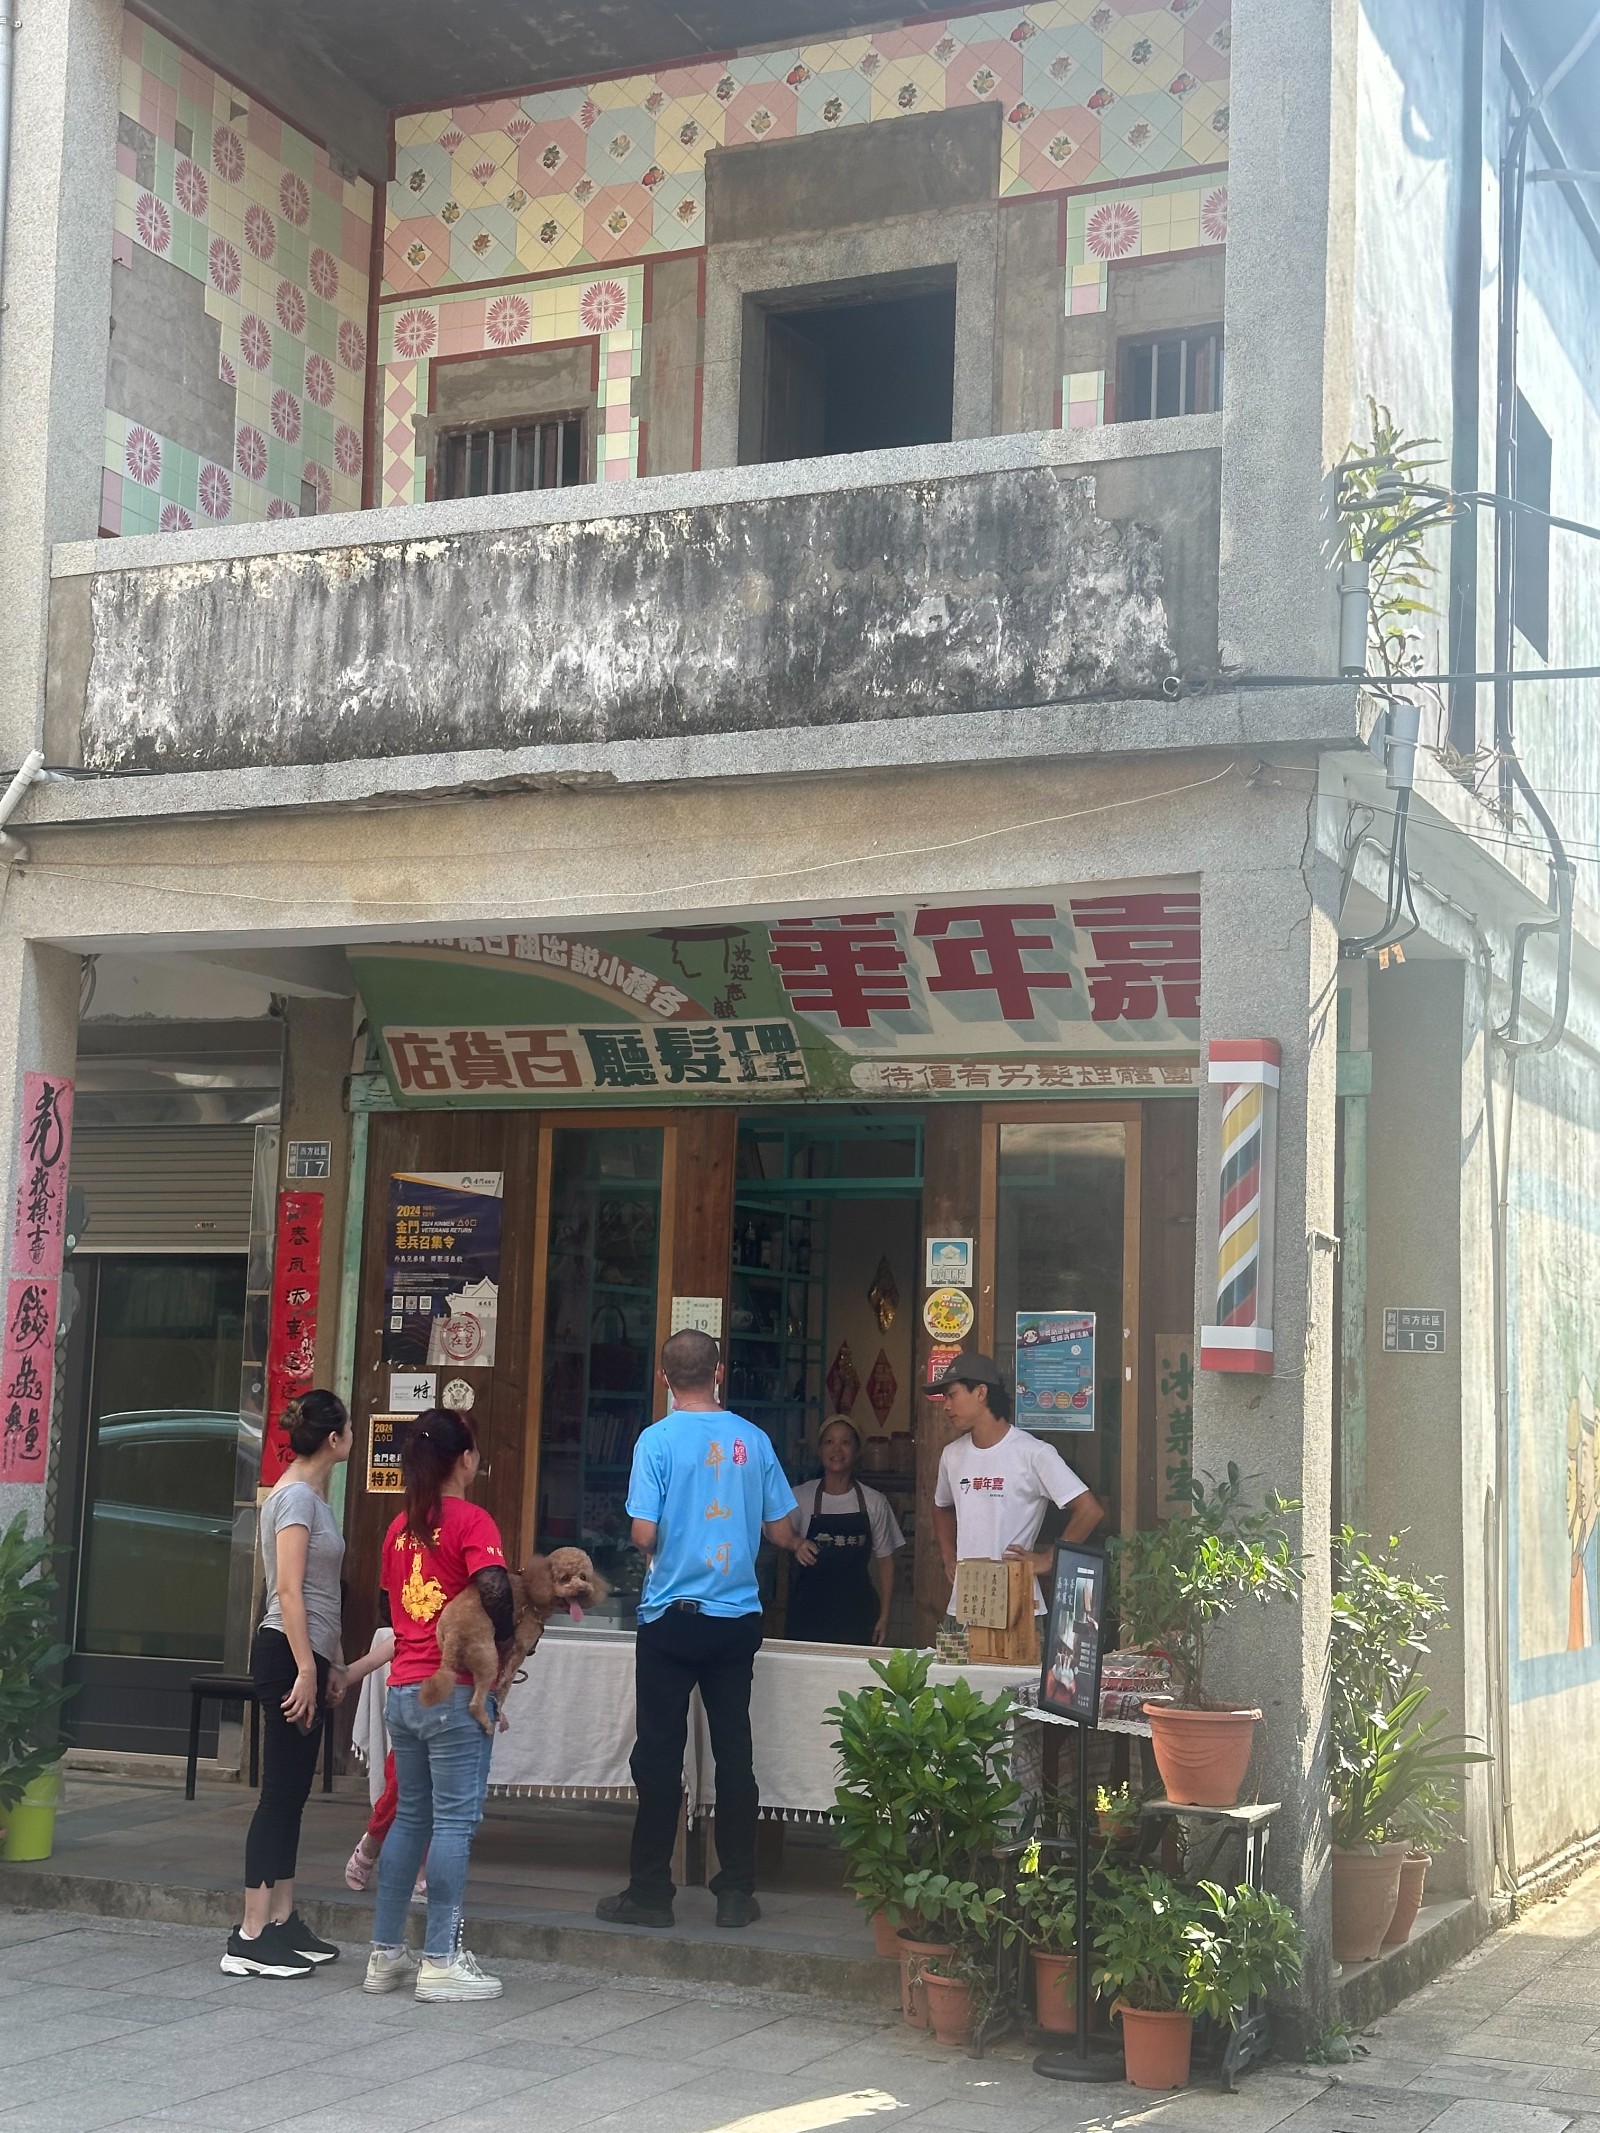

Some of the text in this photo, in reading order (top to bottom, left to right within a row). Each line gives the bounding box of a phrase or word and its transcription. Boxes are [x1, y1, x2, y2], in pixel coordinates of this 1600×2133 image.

[304, 1161, 325, 1176] 17
[396, 1205, 421, 1217] 2024
[396, 1220, 420, 1234] 金門
[396, 1235, 455, 1250] 老兵召集令
[694, 1319, 708, 1330] 19
[1401, 1314, 1440, 1326] 西方社區
[1408, 1333, 1438, 1350] 19
[413, 1380, 431, 1399] 特
[371, 1471, 404, 1487] 特約
